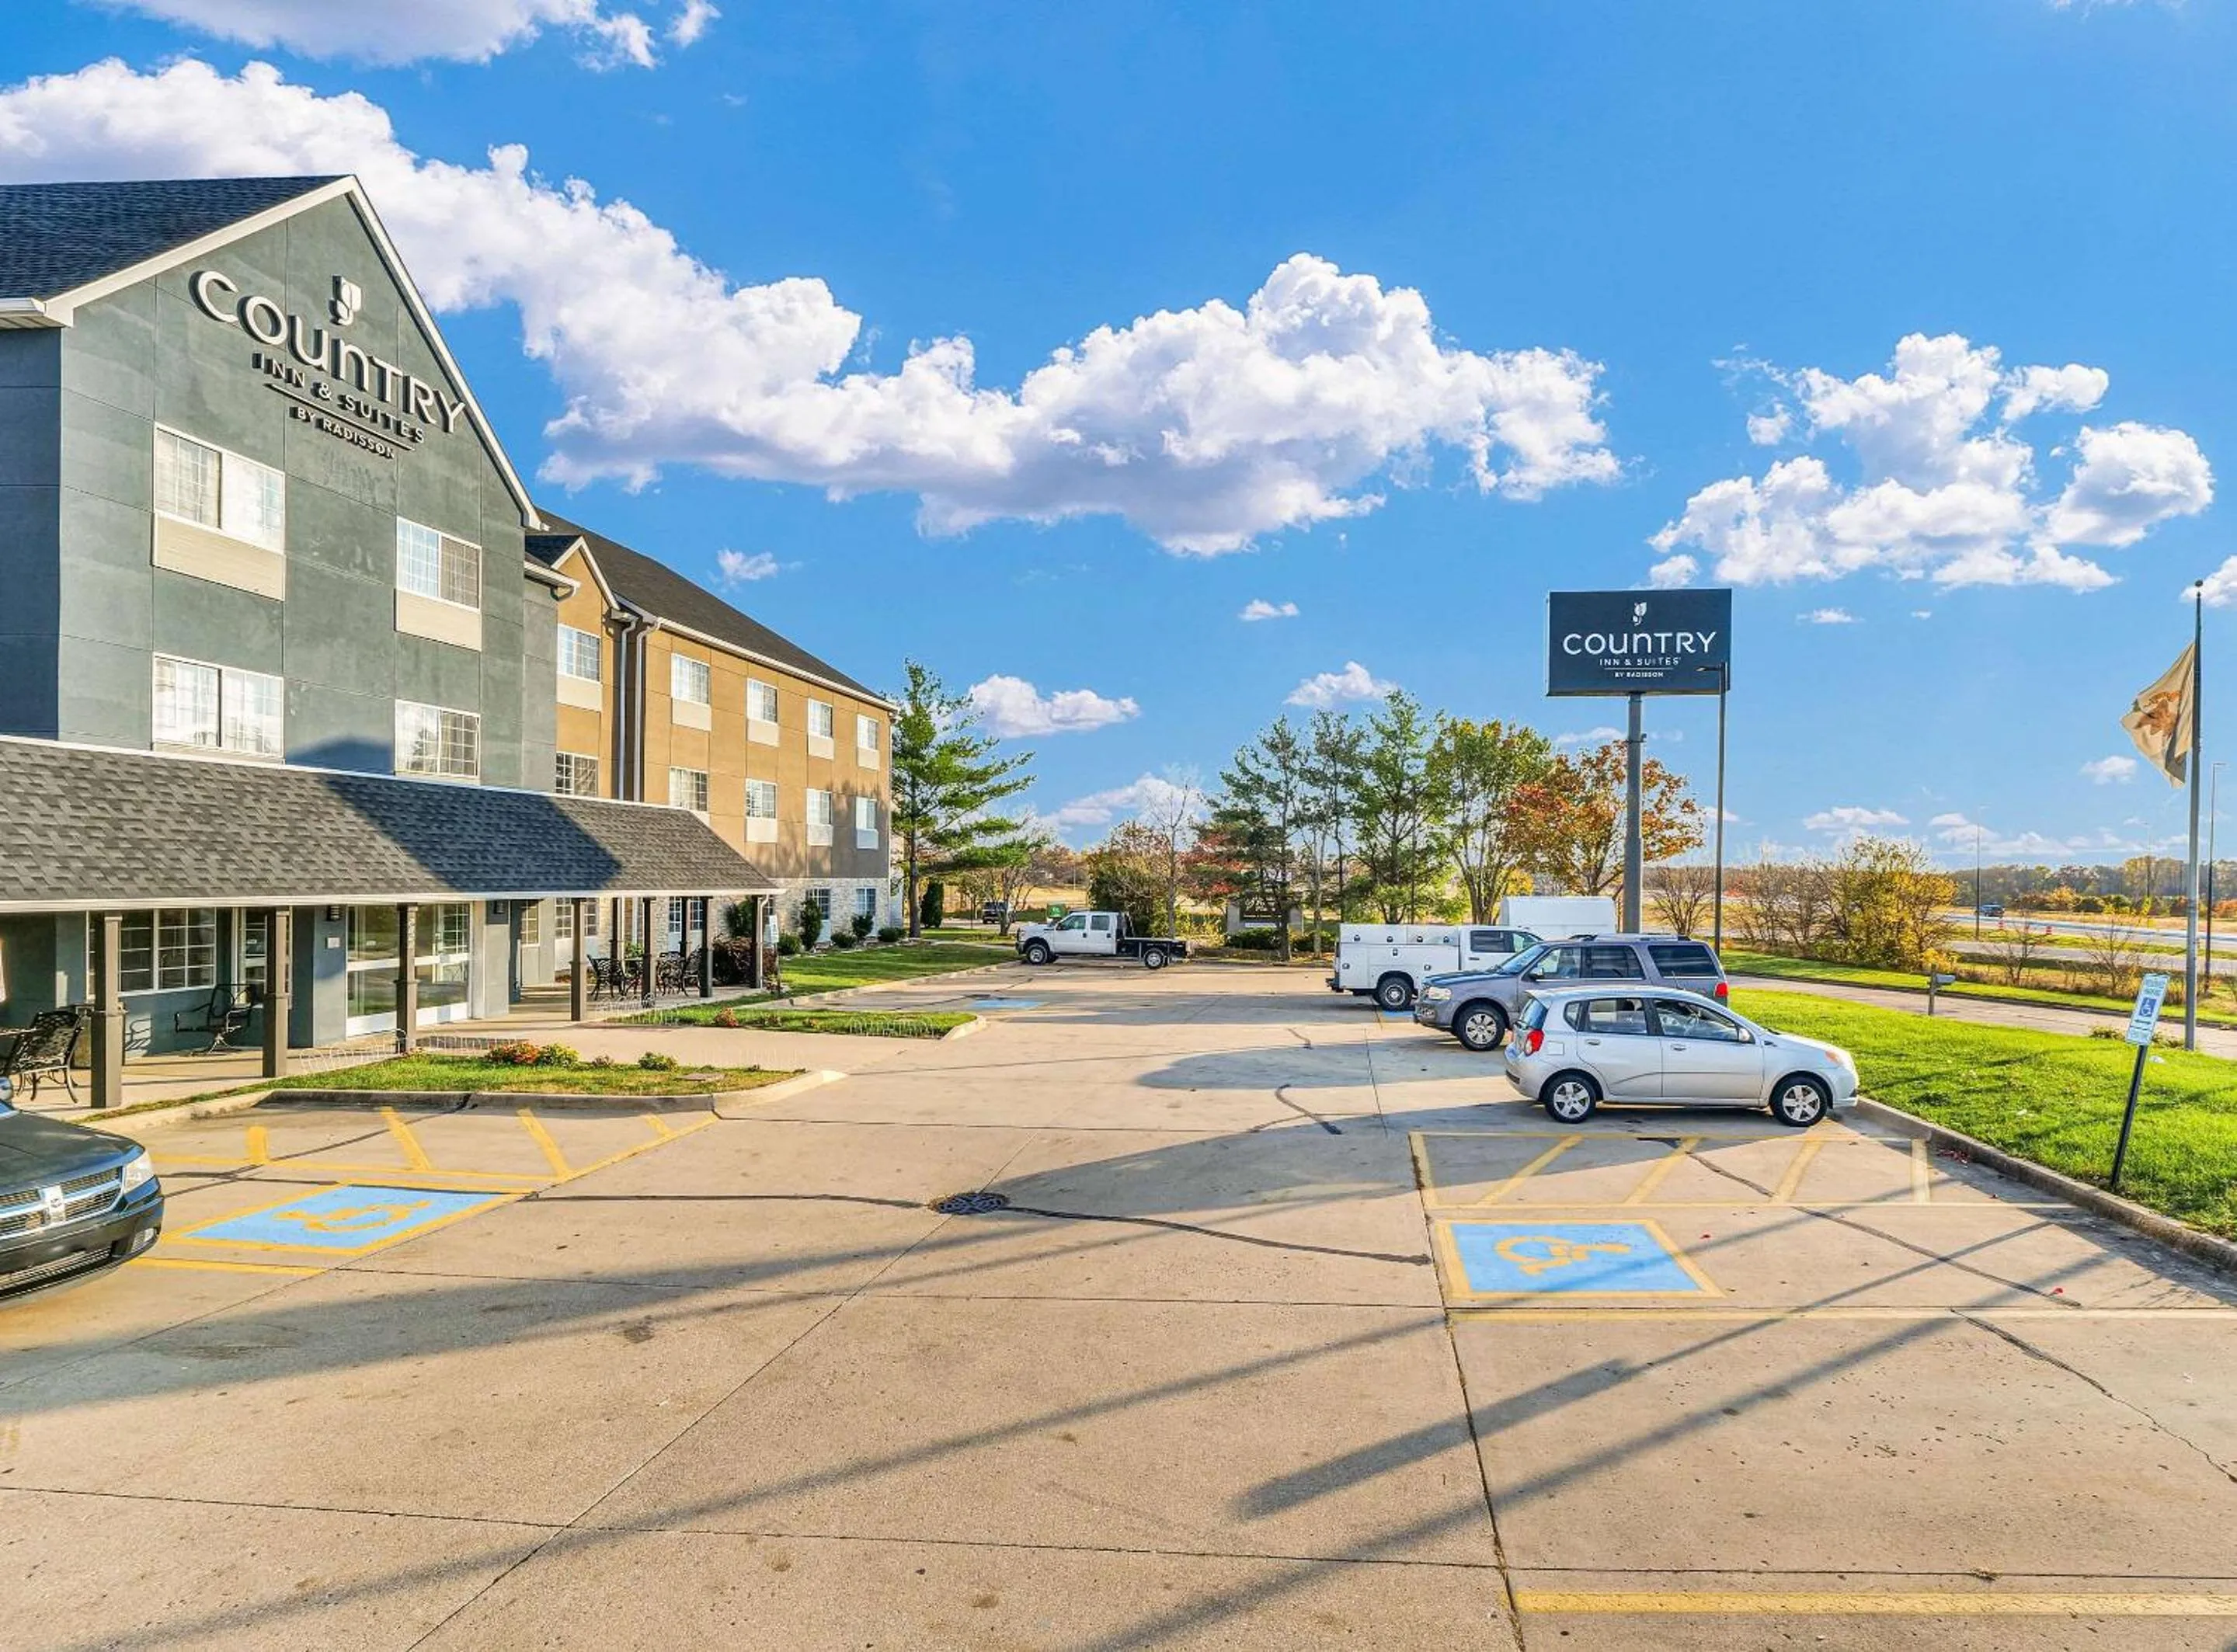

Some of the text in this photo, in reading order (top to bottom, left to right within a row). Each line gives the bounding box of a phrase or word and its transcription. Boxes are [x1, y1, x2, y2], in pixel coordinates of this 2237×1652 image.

[253, 353, 424, 443] INN & SUITES
[290, 406, 395, 459] BY RADISSON
[1637, 657, 1679, 666] SUITES
